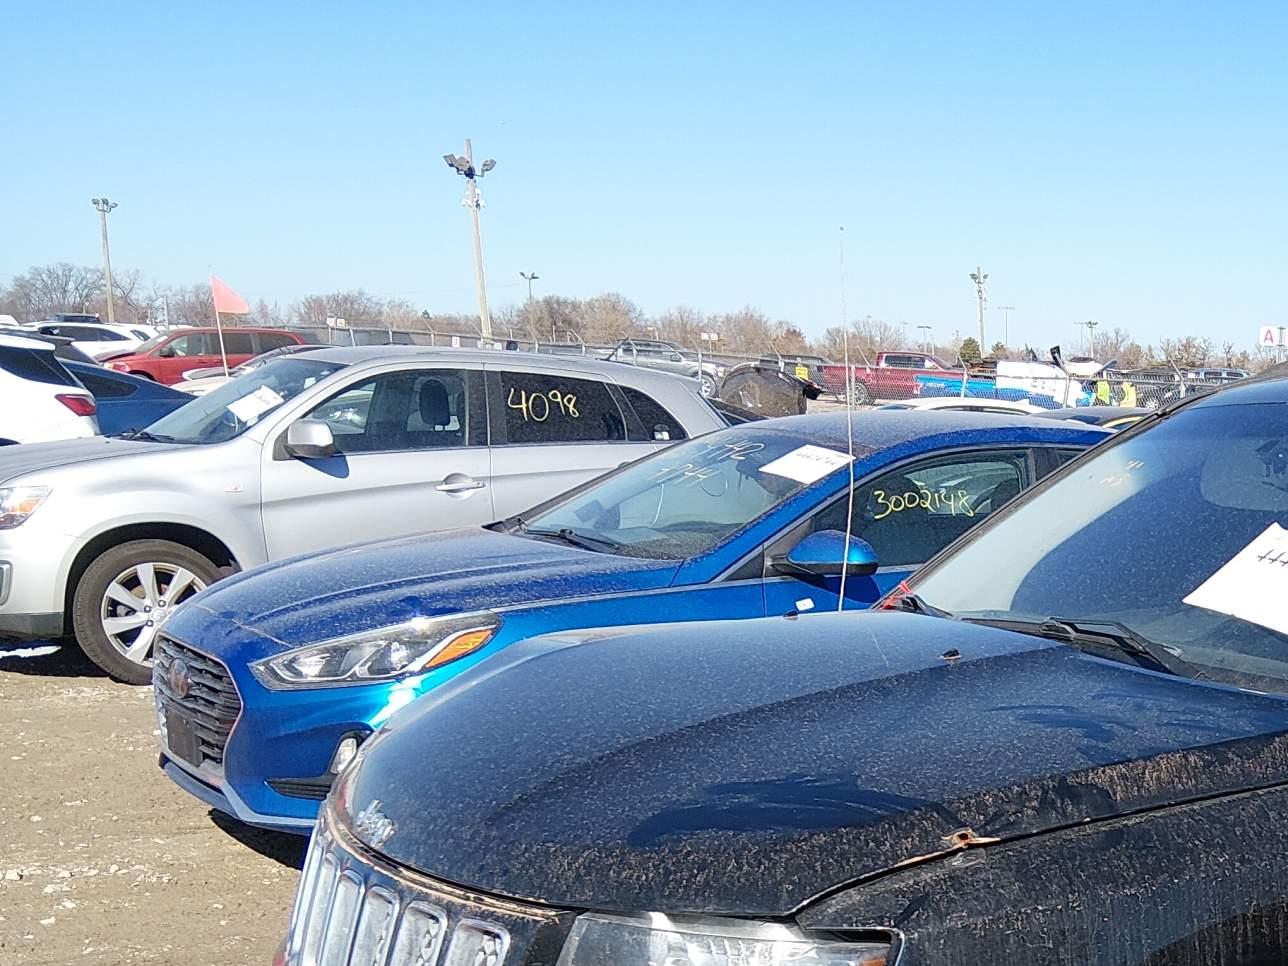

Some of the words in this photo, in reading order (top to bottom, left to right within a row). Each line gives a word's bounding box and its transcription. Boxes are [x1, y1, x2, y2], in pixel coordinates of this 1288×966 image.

[1263, 329, 1274, 344] A
[507, 387, 579, 421] 4098
[873, 488, 974, 519] 3002148
